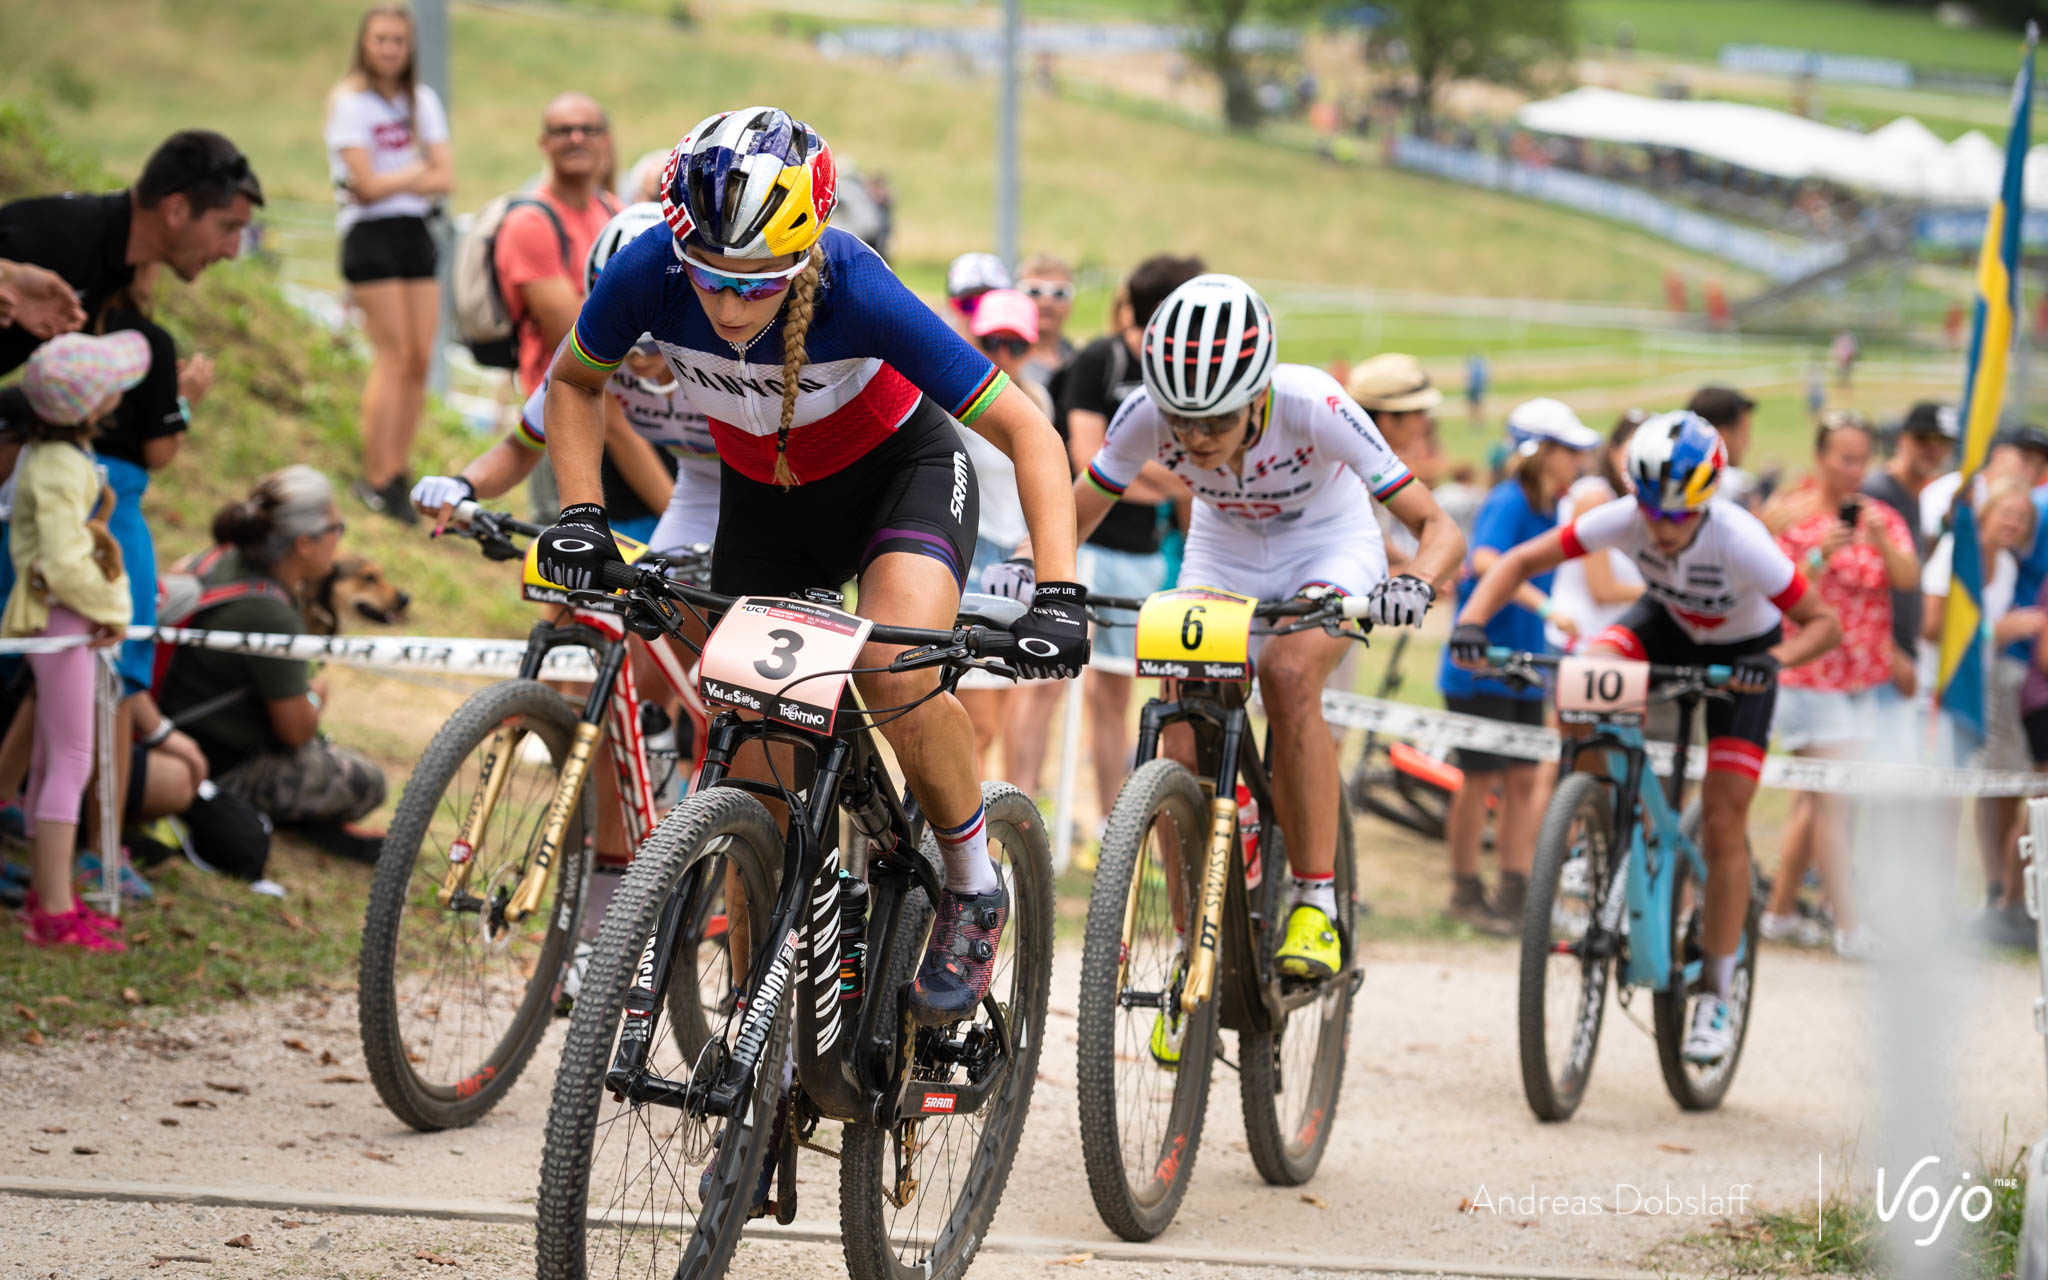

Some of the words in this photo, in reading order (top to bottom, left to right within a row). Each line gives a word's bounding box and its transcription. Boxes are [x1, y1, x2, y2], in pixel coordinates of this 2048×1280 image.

[950, 450, 969, 525] SRAM
[588, 506, 602, 516] LITE
[1062, 587, 1077, 596] LITE
[746, 605, 767, 614] UCI
[1181, 605, 1207, 651] 6
[753, 629, 804, 680] 3
[705, 681, 724, 699] Val
[724, 691, 733, 701] di
[732, 690, 761, 711] Sole
[1584, 669, 1624, 703] 10
[535, 834, 556, 868] DT
[1204, 847, 1228, 912] SWISS
[1200, 914, 1218, 952] DT
[731, 958, 791, 1067] ROCKSHOX
[923, 1096, 954, 1109] SRAM
